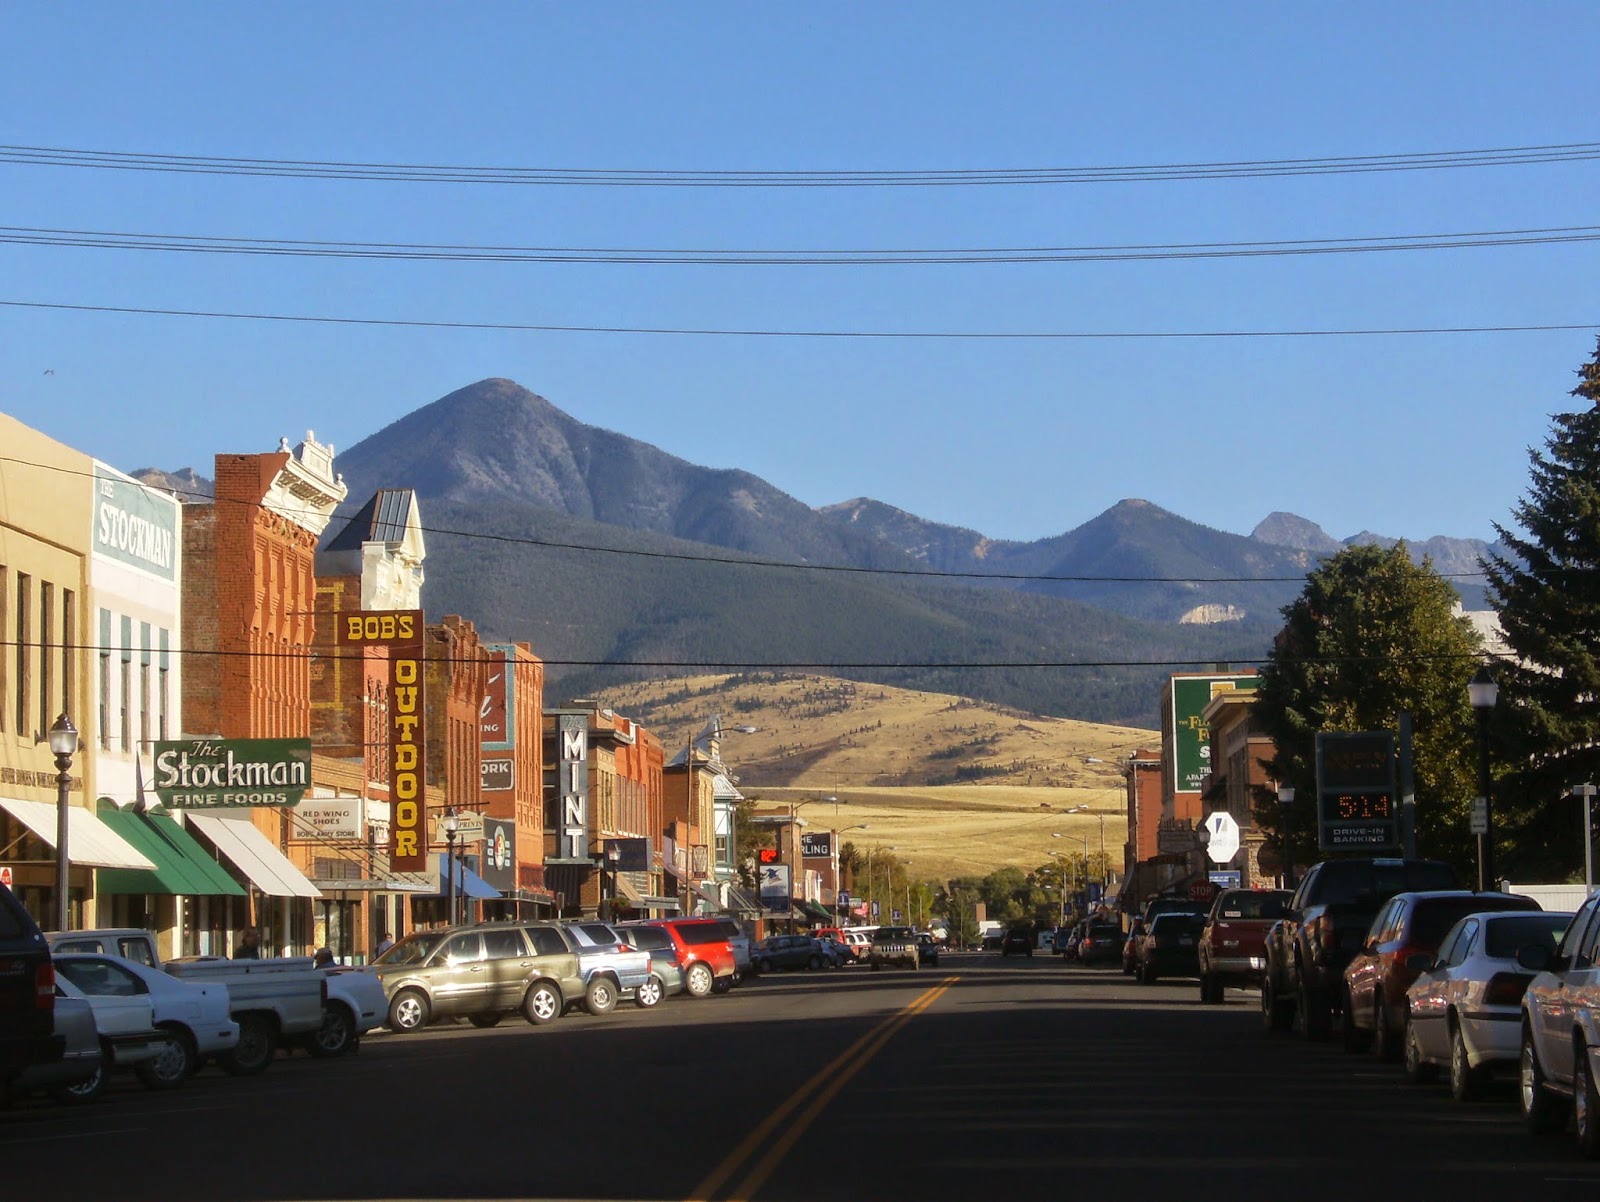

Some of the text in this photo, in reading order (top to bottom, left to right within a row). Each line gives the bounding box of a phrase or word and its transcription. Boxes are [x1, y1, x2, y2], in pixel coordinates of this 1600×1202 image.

[100, 479, 114, 499] THE
[99, 501, 171, 569] STOCKMAN
[347, 613, 414, 640] BOB'S
[480, 723, 500, 732] ING
[189, 741, 221, 757] The
[394, 659, 418, 858] OUTDOOR
[156, 748, 307, 788] Stockman
[481, 763, 509, 775] ORK
[172, 793, 287, 805] FINE FOODS
[562, 728, 587, 859] MINT
[1333, 835, 1385, 843] BANKING
[800, 844, 828, 854] RLING
[1190, 887, 1212, 896] STOP
